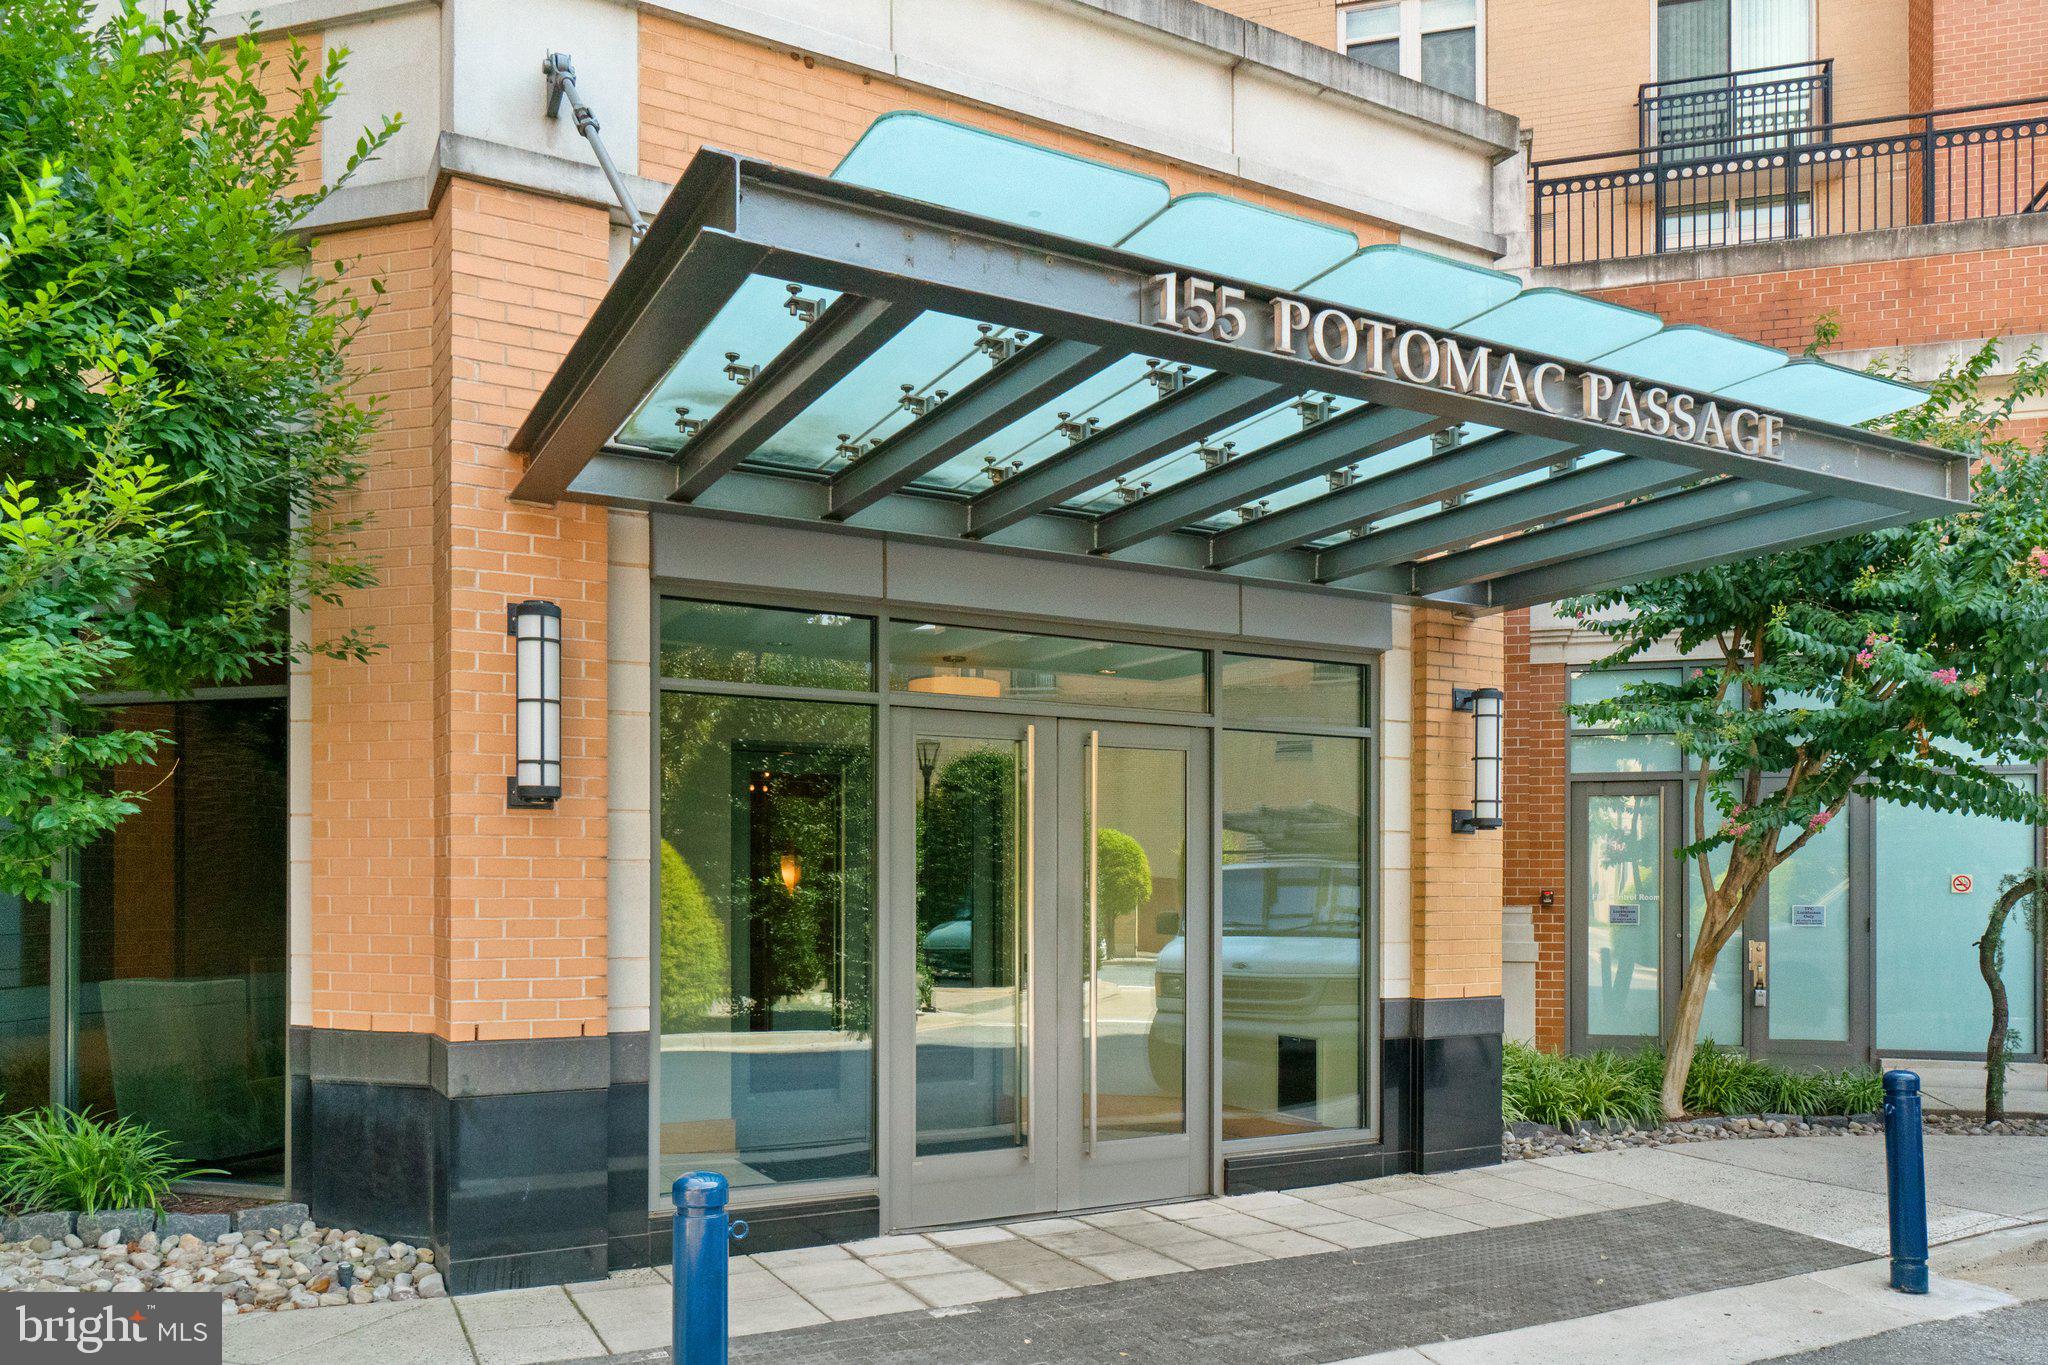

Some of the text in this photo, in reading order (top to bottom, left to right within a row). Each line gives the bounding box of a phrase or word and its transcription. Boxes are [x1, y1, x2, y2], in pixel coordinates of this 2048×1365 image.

[1149, 272, 1784, 460] 155 POTOMAC PASSAGE
[1639, 893, 1660, 901] Room
